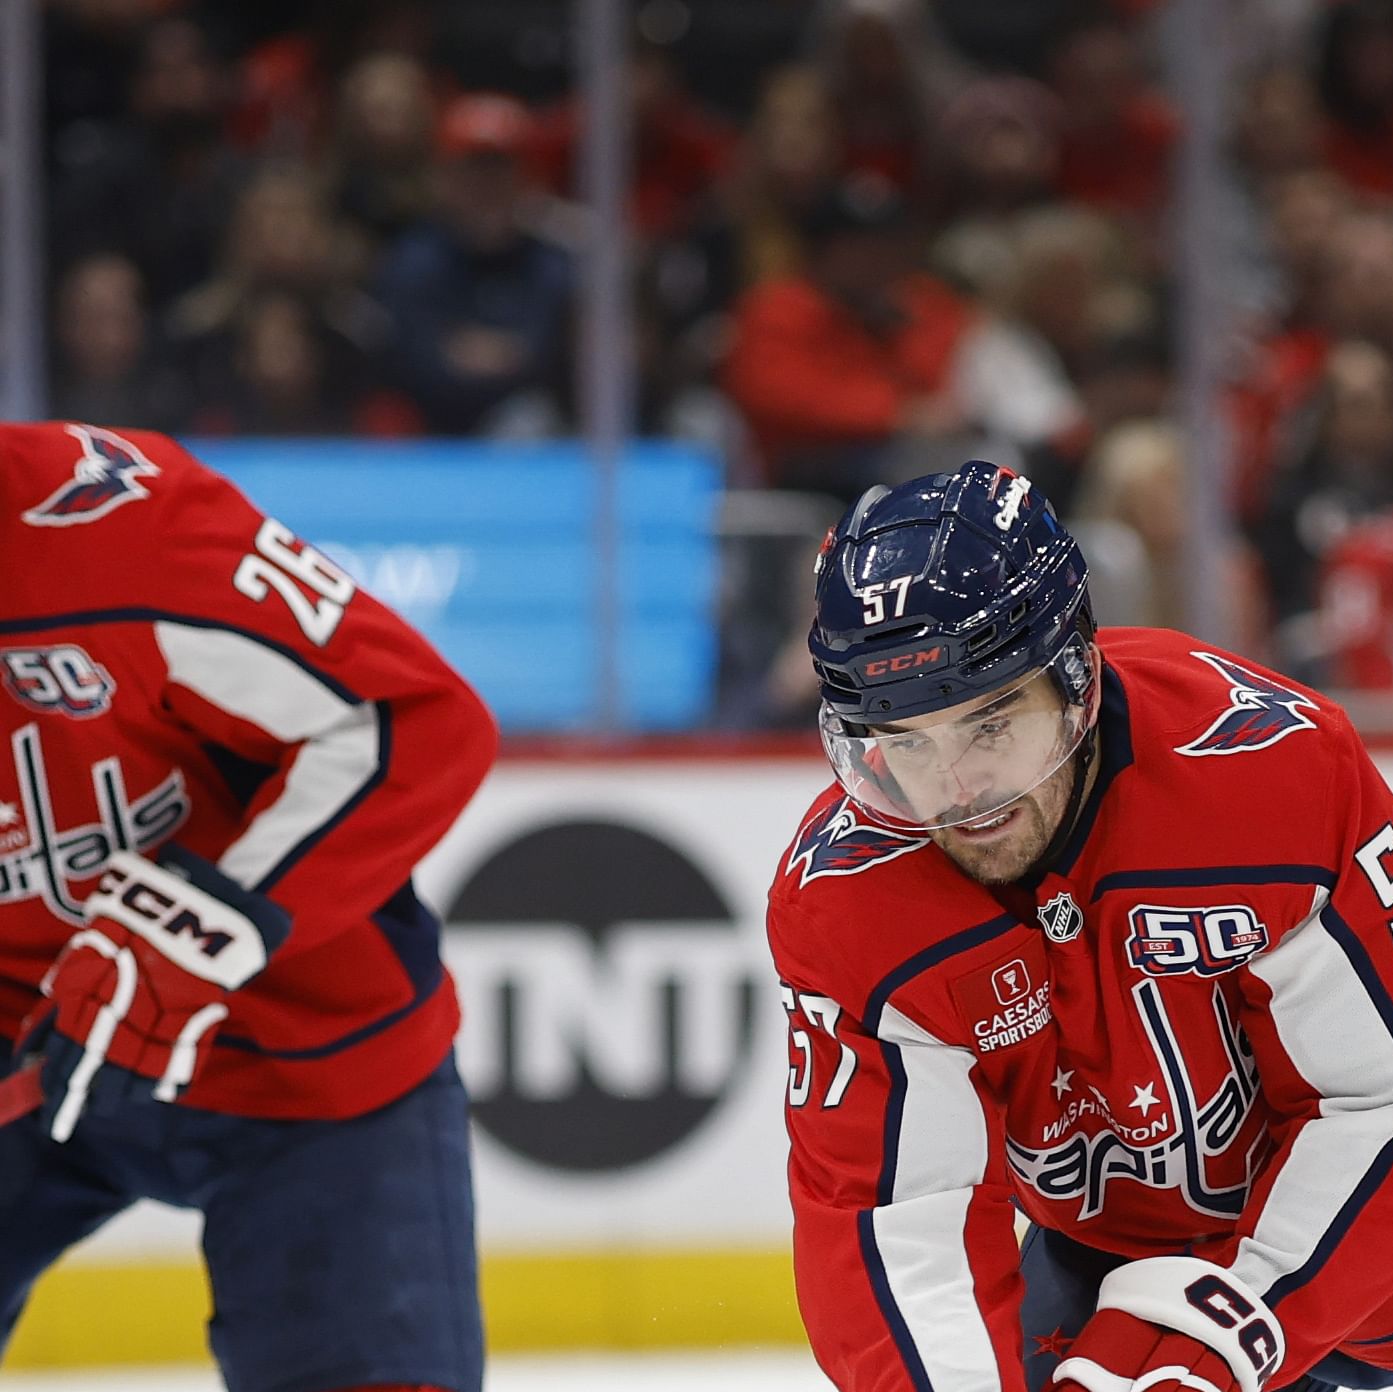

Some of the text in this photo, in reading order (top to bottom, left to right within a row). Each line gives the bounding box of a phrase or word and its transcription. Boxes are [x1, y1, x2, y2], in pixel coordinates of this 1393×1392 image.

[234, 519, 357, 646] 26
[862, 576, 912, 626] 57
[4, 648, 106, 703] 50
[864, 647, 941, 677] CCM
[1055, 905, 1070, 936] NHL
[1144, 911, 1258, 965] 50
[1148, 941, 1169, 951] EST
[1233, 933, 1260, 944] 1974
[443, 920, 760, 1099] TNT
[780, 980, 858, 1109] 57
